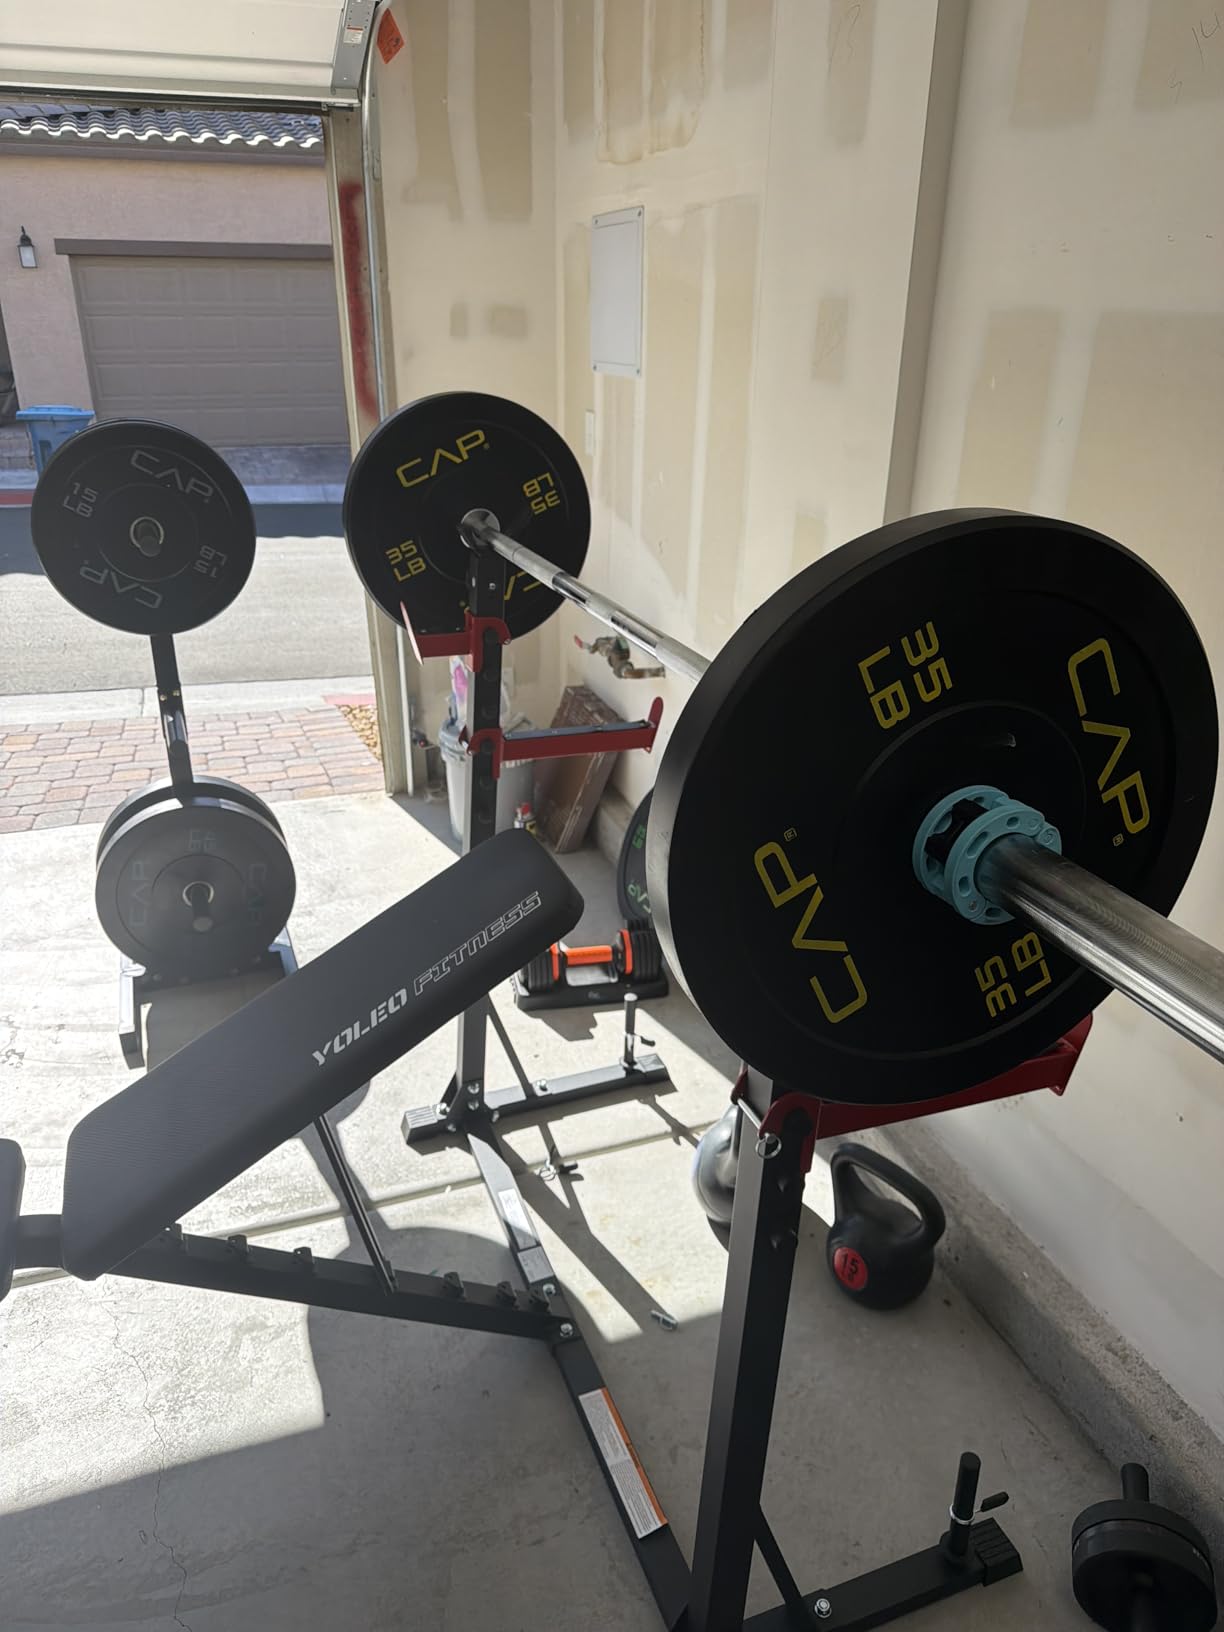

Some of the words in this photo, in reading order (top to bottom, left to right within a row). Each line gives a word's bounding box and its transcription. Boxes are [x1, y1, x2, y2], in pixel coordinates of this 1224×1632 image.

[130, 450, 213, 500] CAP
[395, 429, 486, 488] CAP
[522, 472, 554, 497] LB
[62, 495, 94, 518] LB
[72, 482, 98, 502] 15
[530, 492, 561, 515] 35
[385, 540, 417, 565] 35
[393, 558, 426, 582] LB
[79, 562, 163, 609] CAP
[858, 646, 911, 730] LB
[901, 620, 953, 703] 35
[1068, 638, 1150, 838] CAP
[754, 838, 868, 1024] CAP
[312, 988, 408, 1067] YOLEO
[413, 891, 541, 996] FITNESS
[974, 955, 1017, 1018] 35
[1011, 931, 1052, 998] LB
